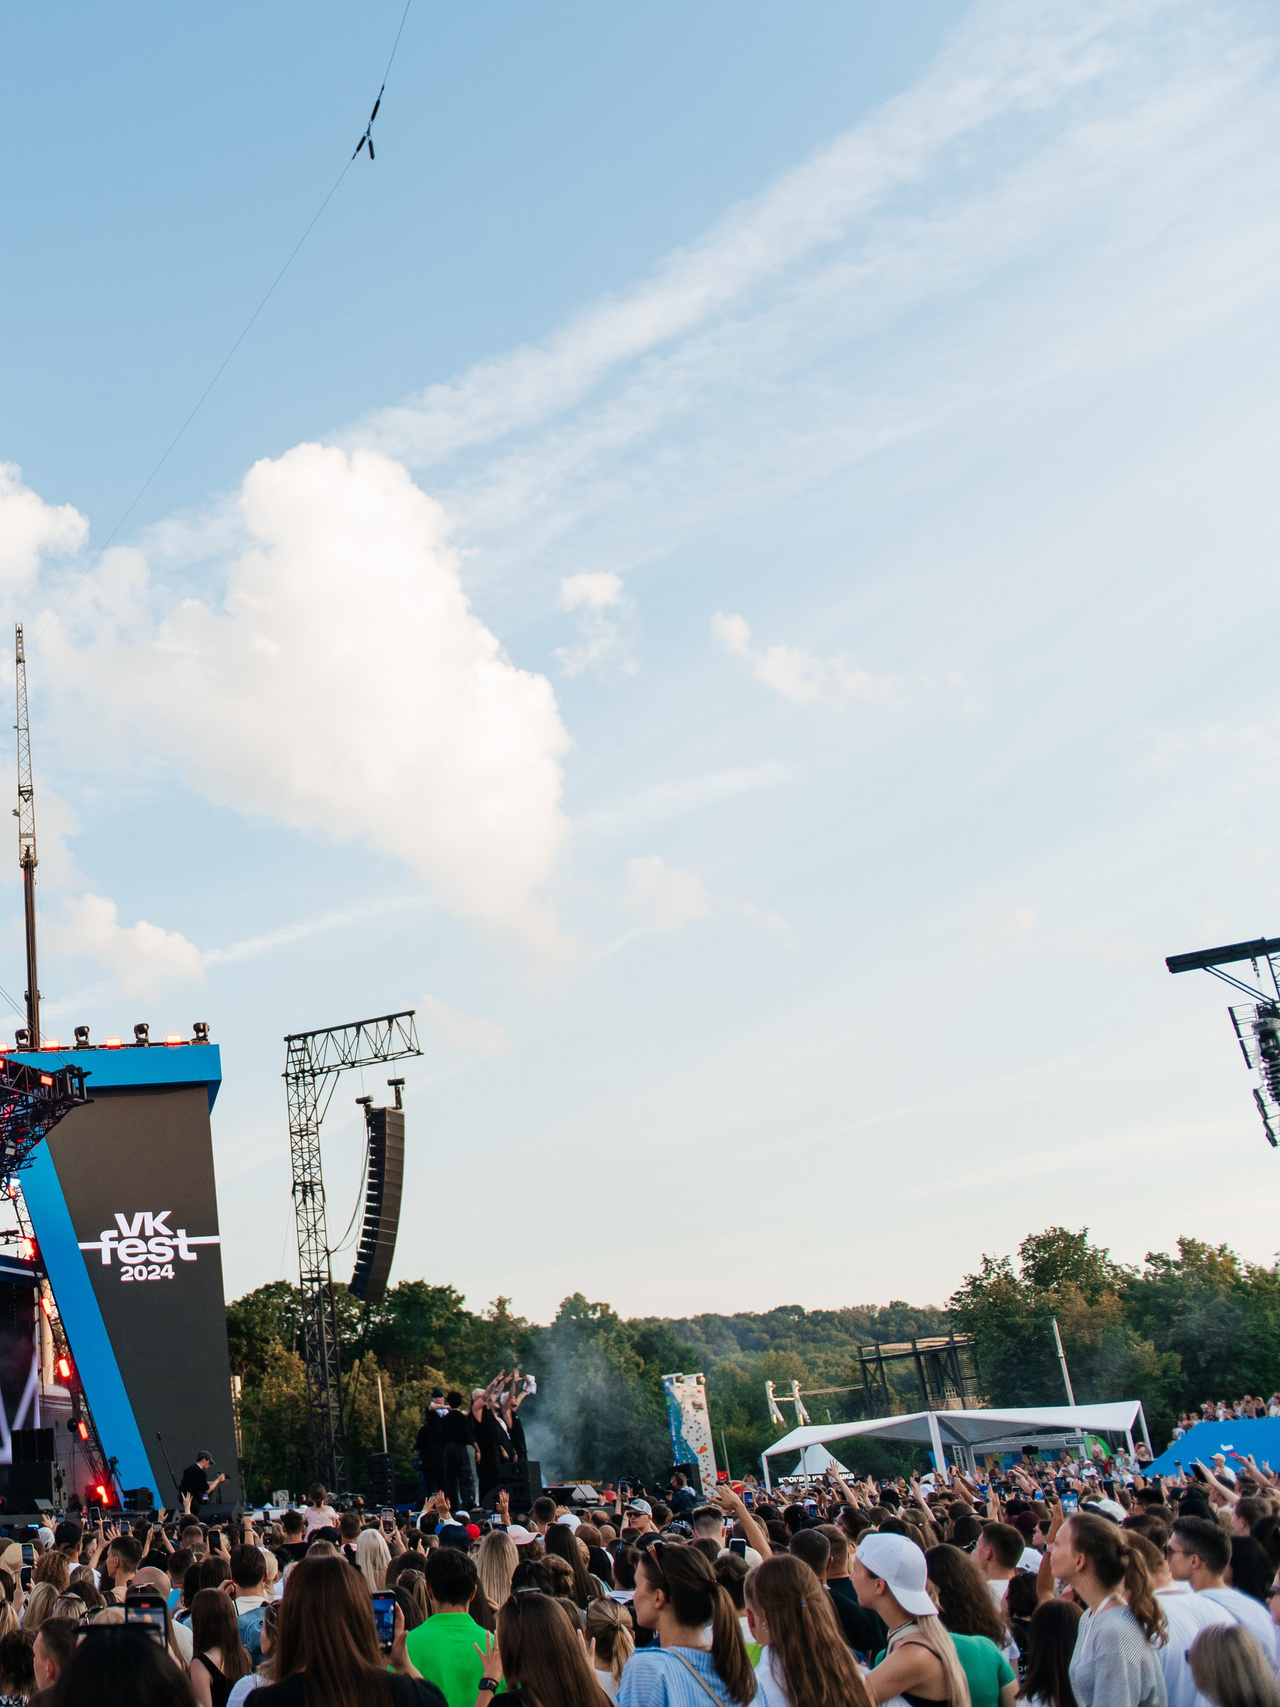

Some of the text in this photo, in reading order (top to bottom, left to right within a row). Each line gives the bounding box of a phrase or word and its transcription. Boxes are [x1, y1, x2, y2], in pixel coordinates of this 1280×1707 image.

[114, 1210, 175, 1238] VK
[99, 1228, 198, 1265] fest
[120, 1263, 176, 1282] 2024
